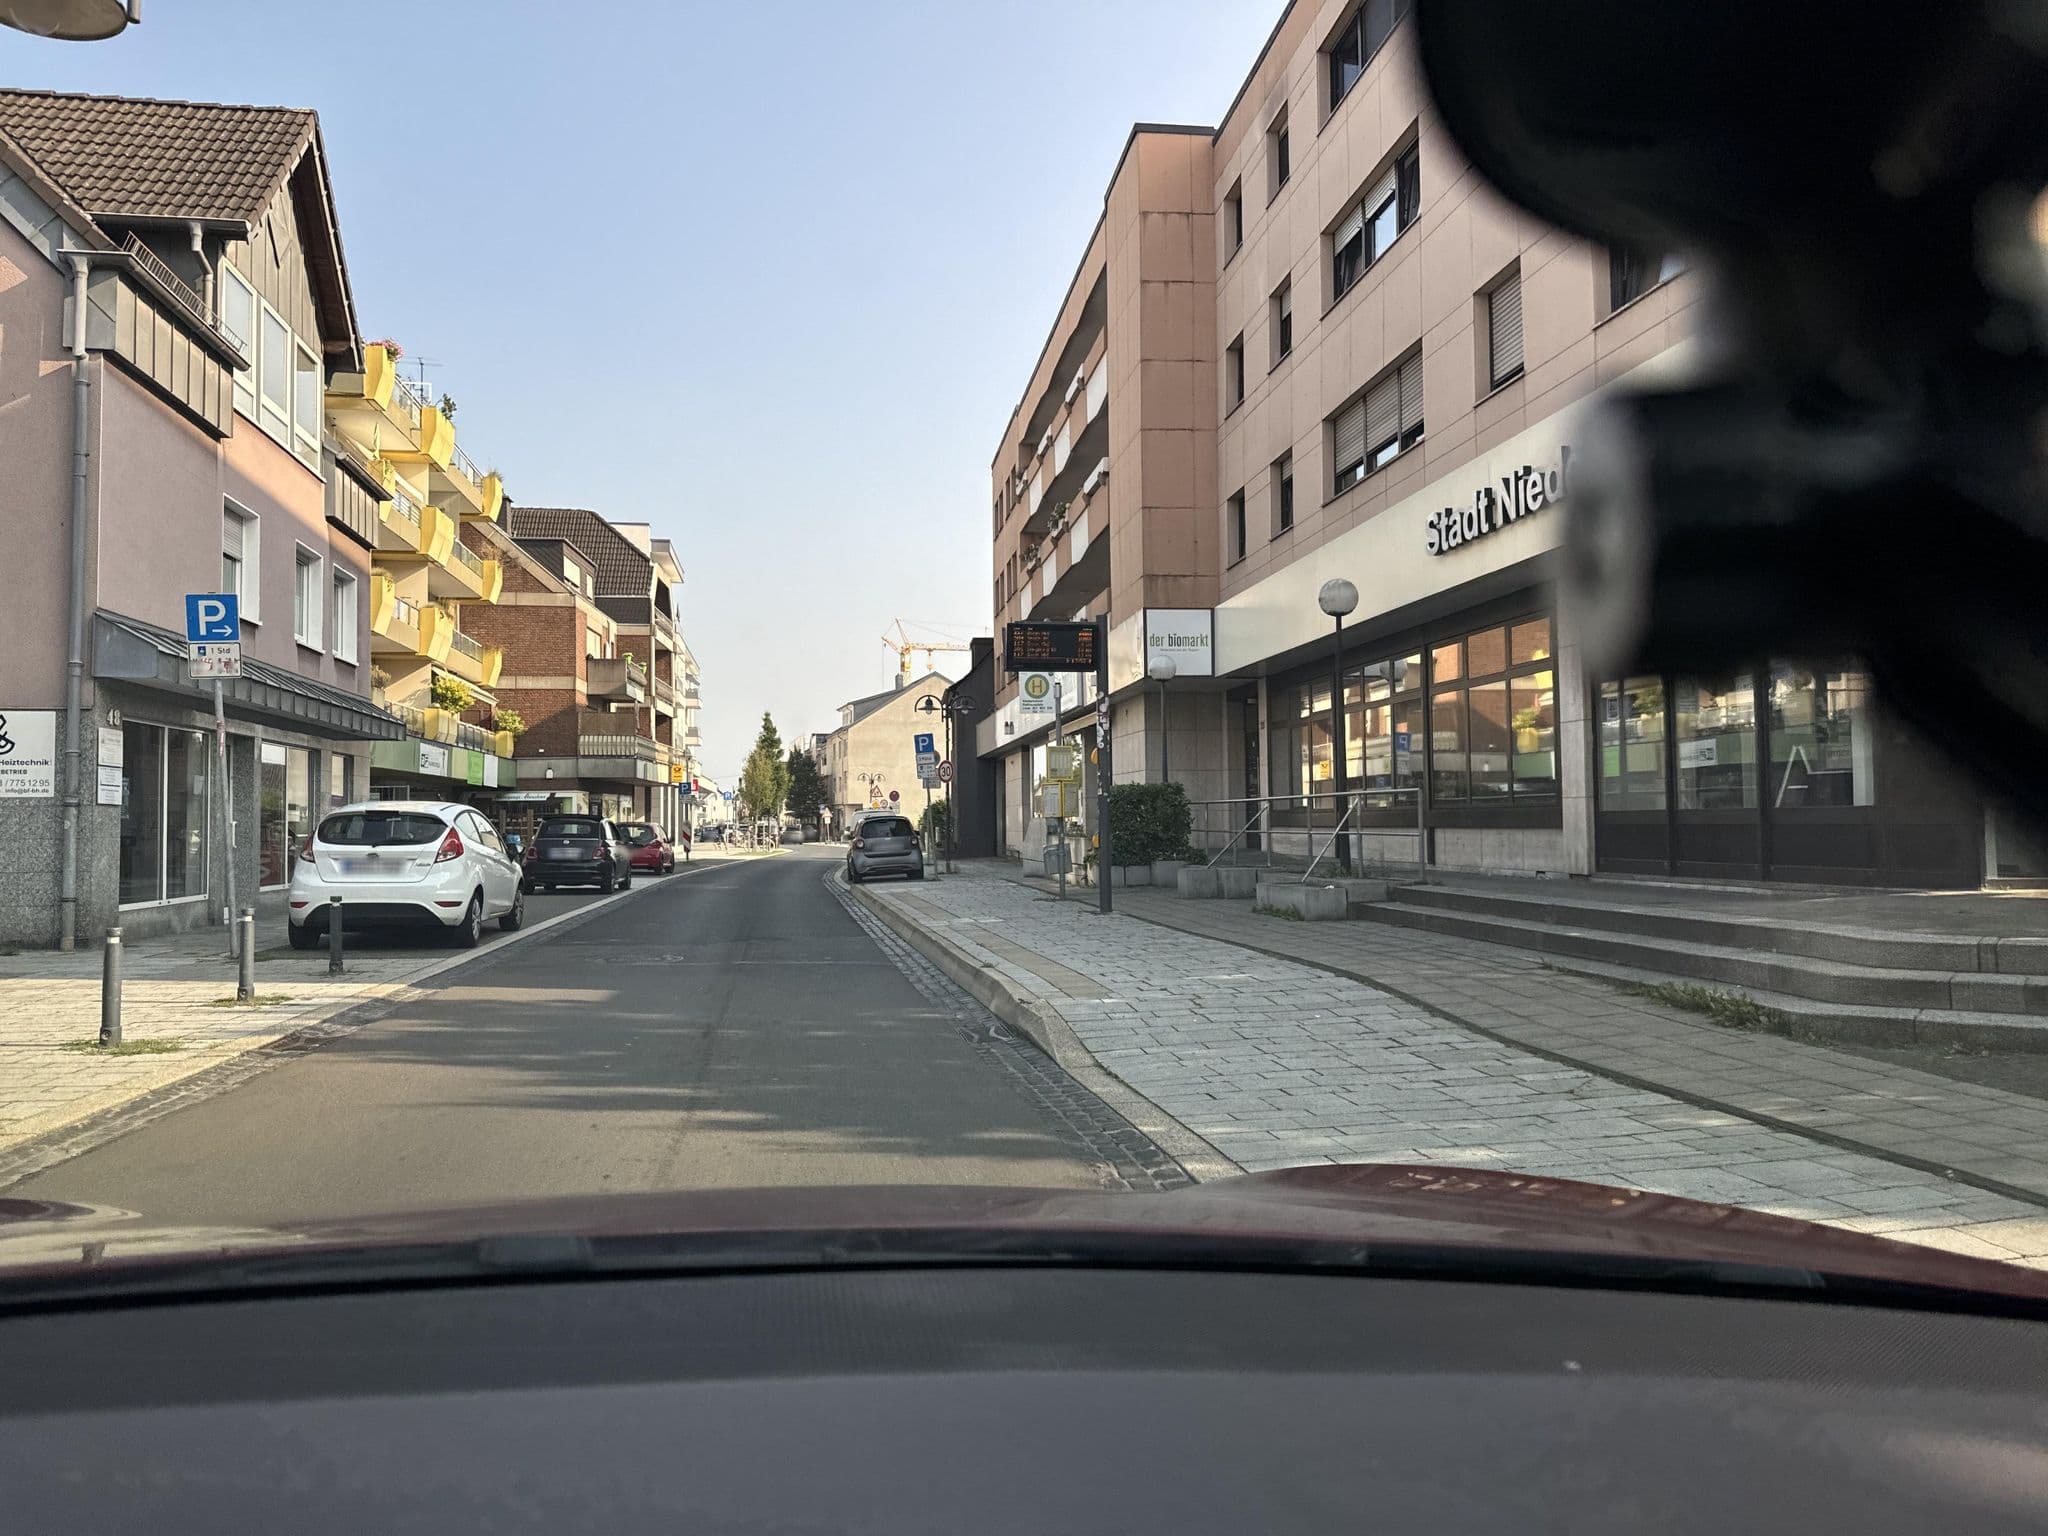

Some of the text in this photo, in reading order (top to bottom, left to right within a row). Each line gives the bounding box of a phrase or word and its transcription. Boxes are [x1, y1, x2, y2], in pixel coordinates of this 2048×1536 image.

[1426, 445, 1572, 556] Stadt Nied
[198, 600, 226, 636] P
[1150, 633, 1208, 647] der biomarkt
[106, 709, 121, 725] 48
[919, 737, 928, 751] P
[941, 766, 950, 777] 30
